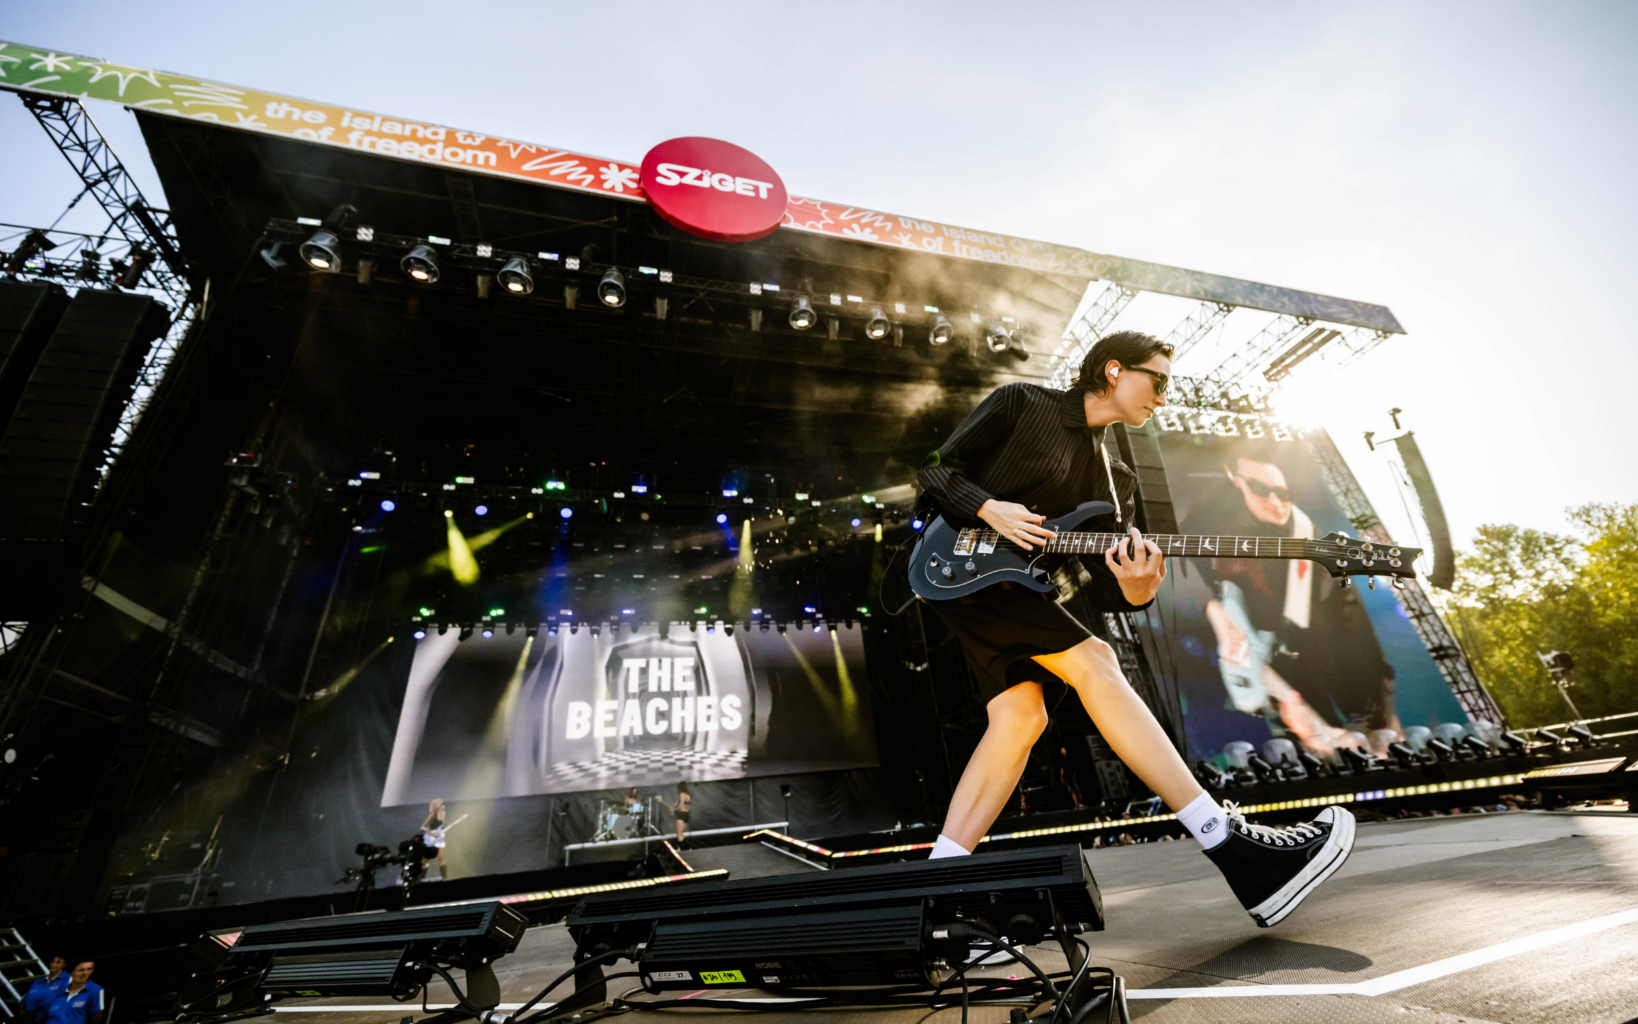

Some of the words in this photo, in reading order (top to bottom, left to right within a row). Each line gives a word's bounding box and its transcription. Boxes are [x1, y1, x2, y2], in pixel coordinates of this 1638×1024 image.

[265, 102, 327, 124] the
[341, 111, 447, 141] island
[293, 126, 336, 143] of
[347, 130, 497, 167] freedom
[898, 216, 936, 234] the
[942, 224, 1006, 248] island
[922, 236, 944, 254] of
[952, 239, 1042, 271] freedom
[623, 657, 695, 693] THE
[565, 694, 742, 740] BEACHES
